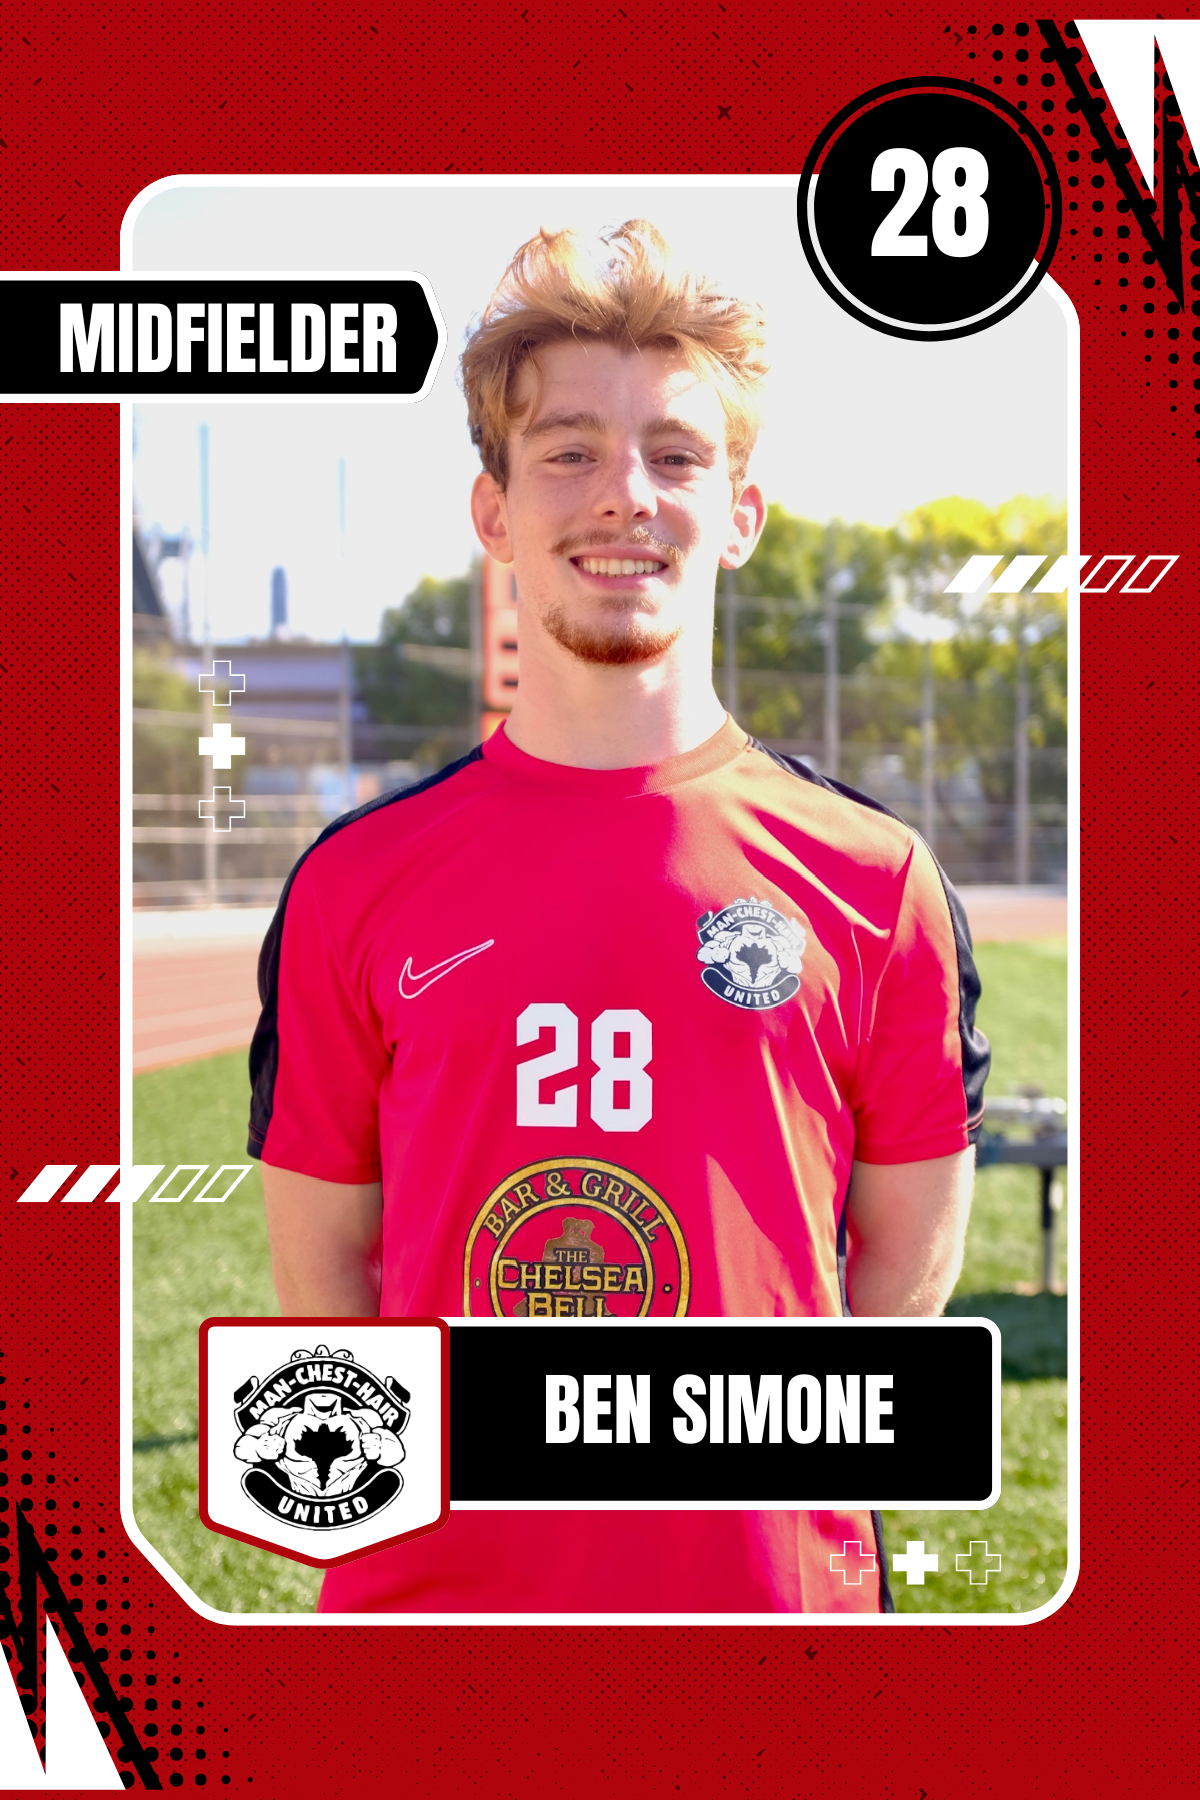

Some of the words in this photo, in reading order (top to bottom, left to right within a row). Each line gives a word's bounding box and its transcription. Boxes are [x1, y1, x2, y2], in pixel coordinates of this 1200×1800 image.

[724, 985, 780, 1005] UNITED
[516, 1003, 653, 1132] 28
[483, 1183, 540, 1239] BAR
[547, 1171, 571, 1197] &
[581, 1172, 665, 1241] GRILL
[556, 1250, 587, 1262] THE
[498, 1258, 645, 1292] CHELSEA
[527, 1292, 605, 1317] BELL
